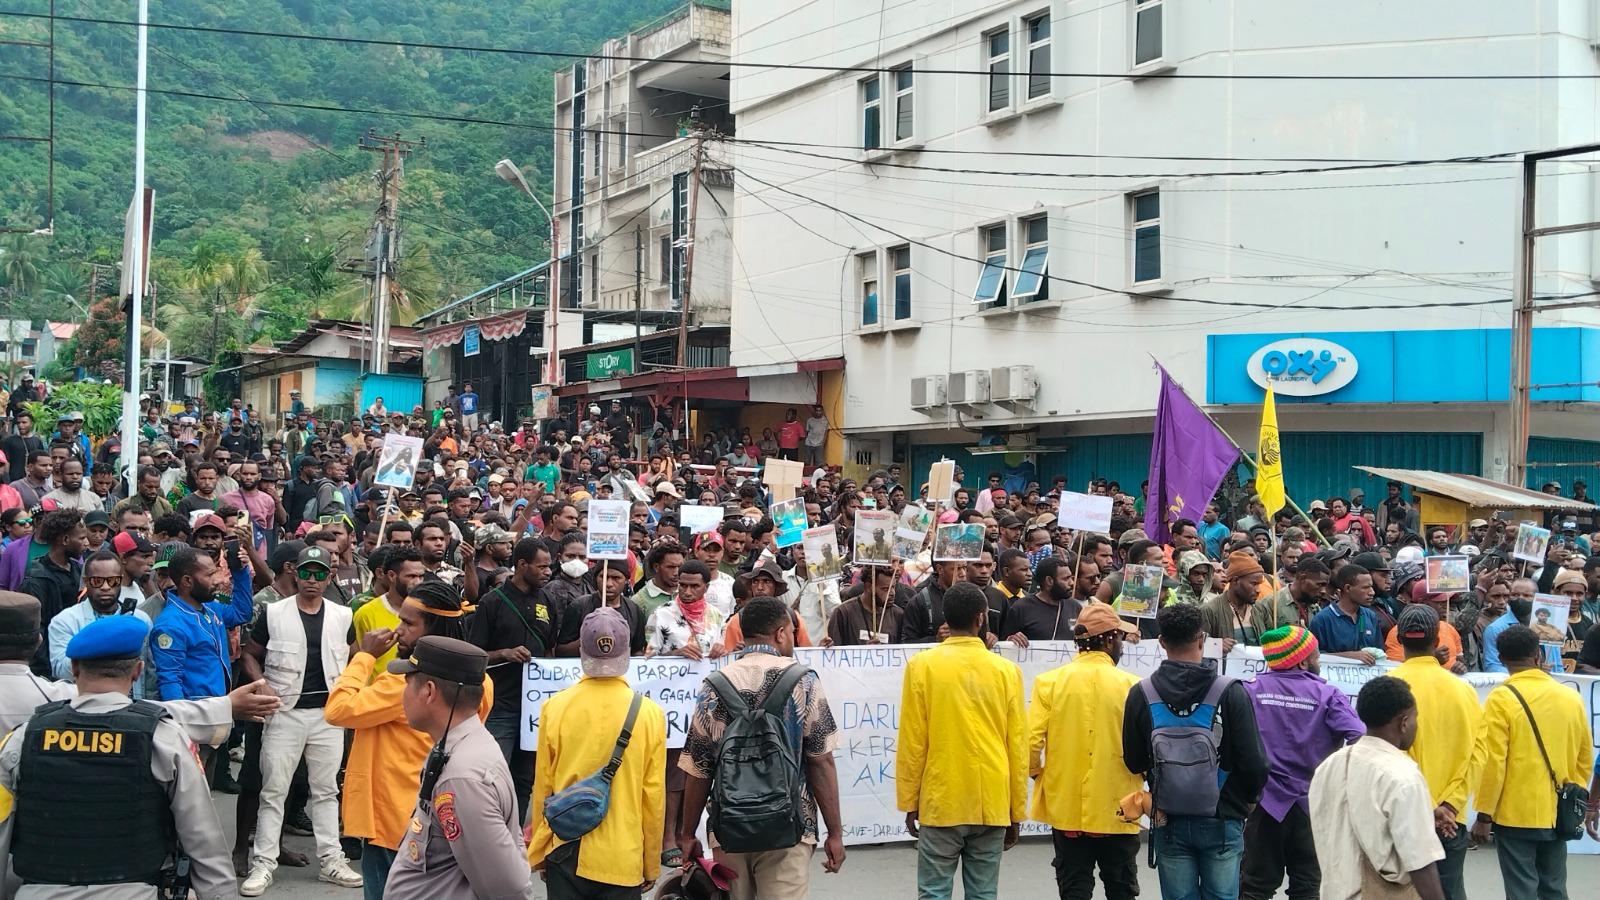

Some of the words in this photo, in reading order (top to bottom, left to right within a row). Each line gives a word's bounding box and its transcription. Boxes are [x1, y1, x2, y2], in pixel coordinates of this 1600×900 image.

[599, 354, 620, 369] STORY
[637, 663, 699, 681] PARPOL
[659, 688, 699, 704] GAGAL
[43, 729, 122, 754] POLISI
